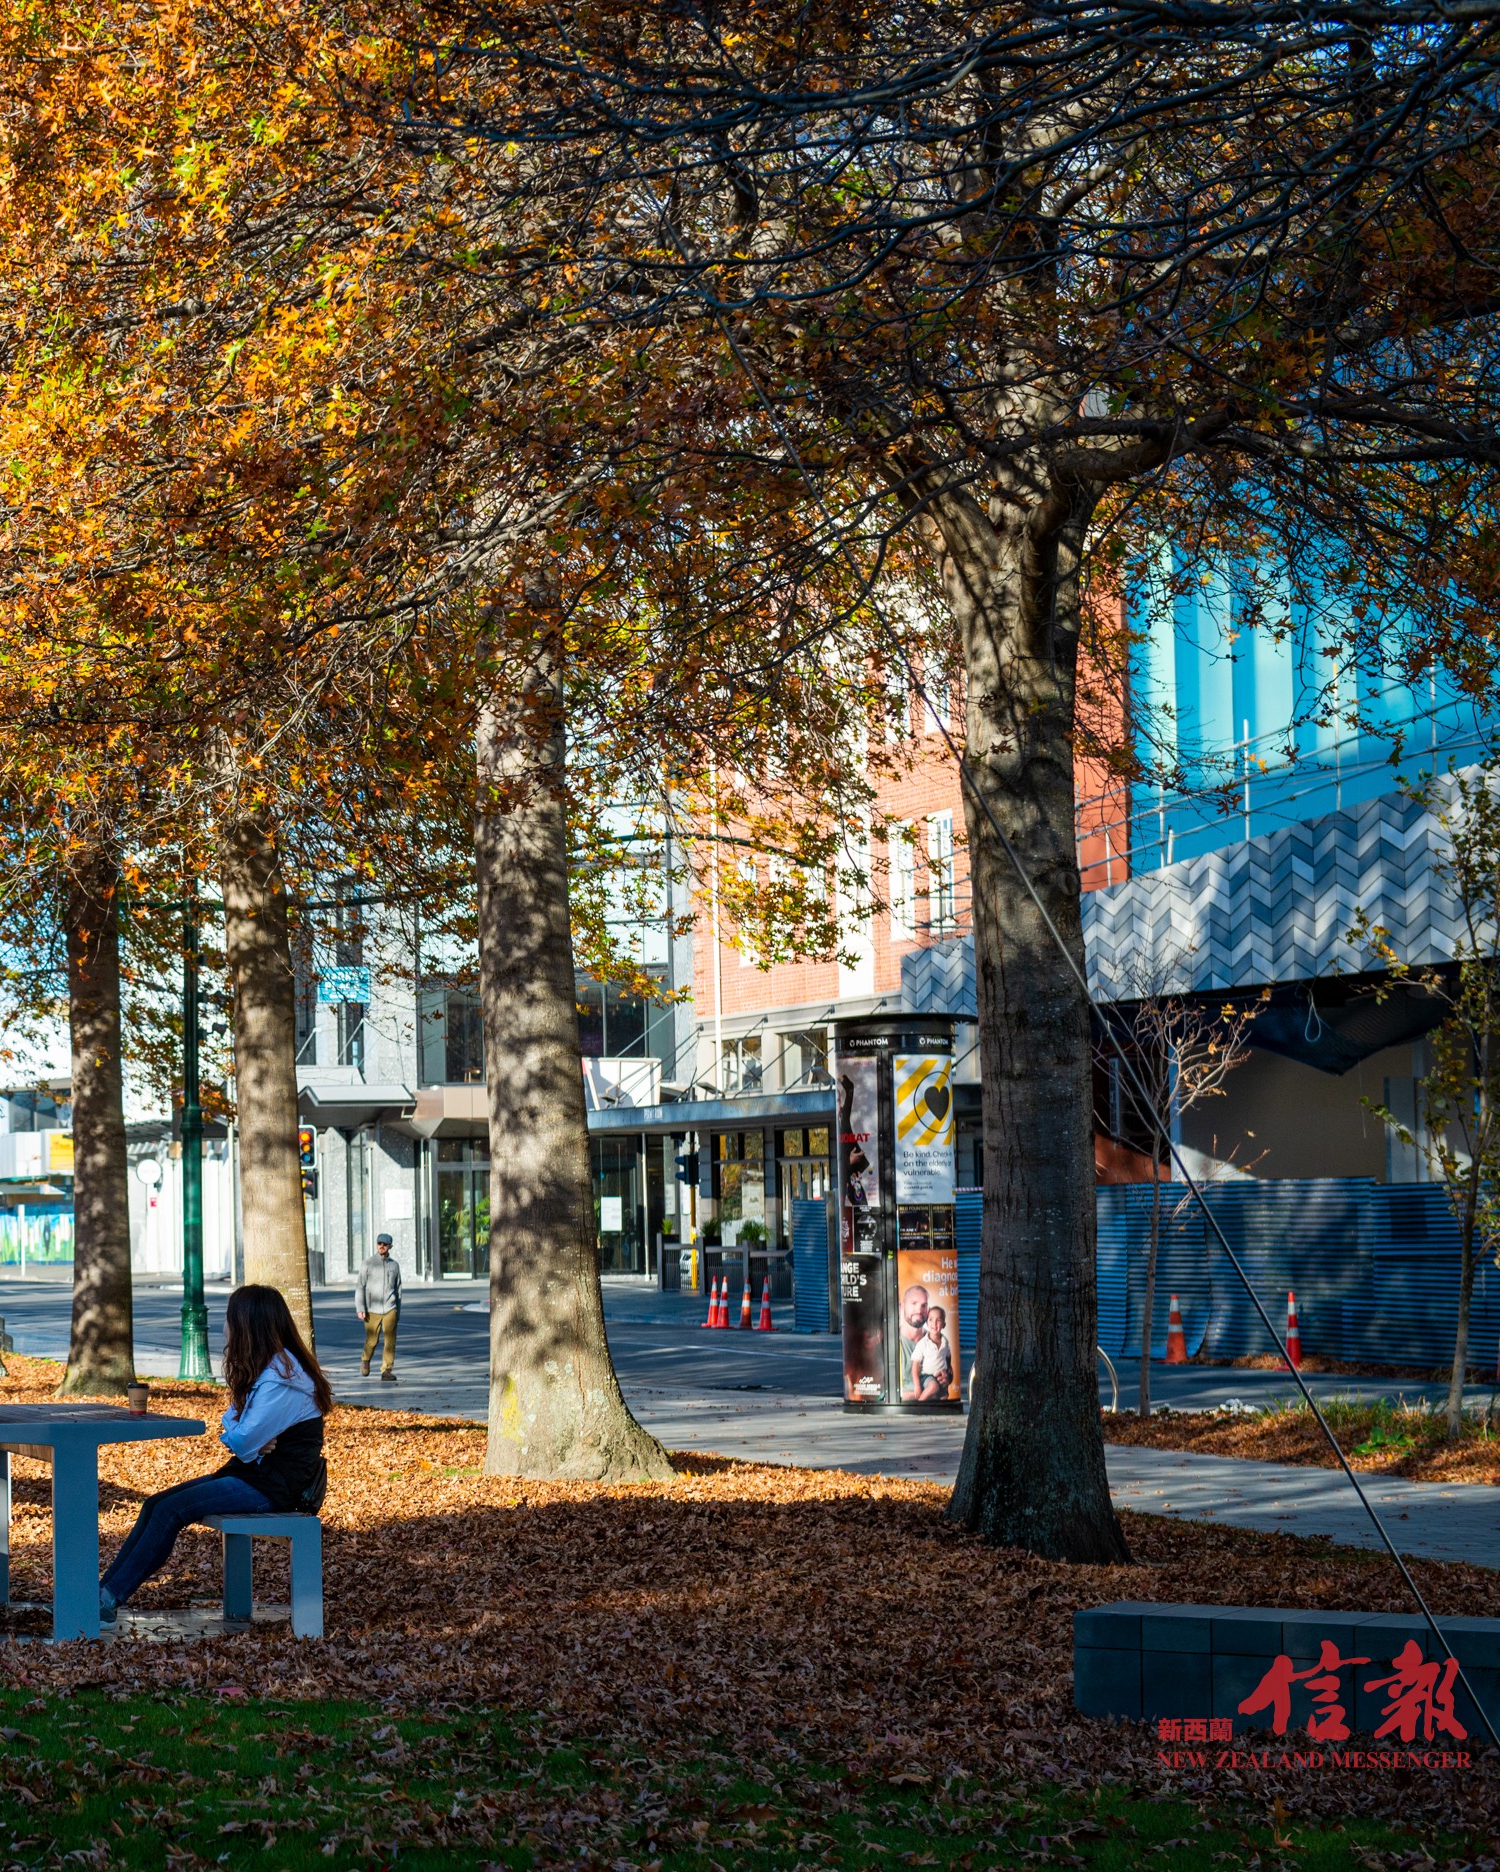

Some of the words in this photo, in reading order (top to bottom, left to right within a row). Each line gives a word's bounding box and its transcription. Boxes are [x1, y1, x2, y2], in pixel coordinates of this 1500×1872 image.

[855, 1038, 889, 1046] PHANTOM
[941, 1256, 953, 1269] He
[938, 1285, 949, 1296] at
